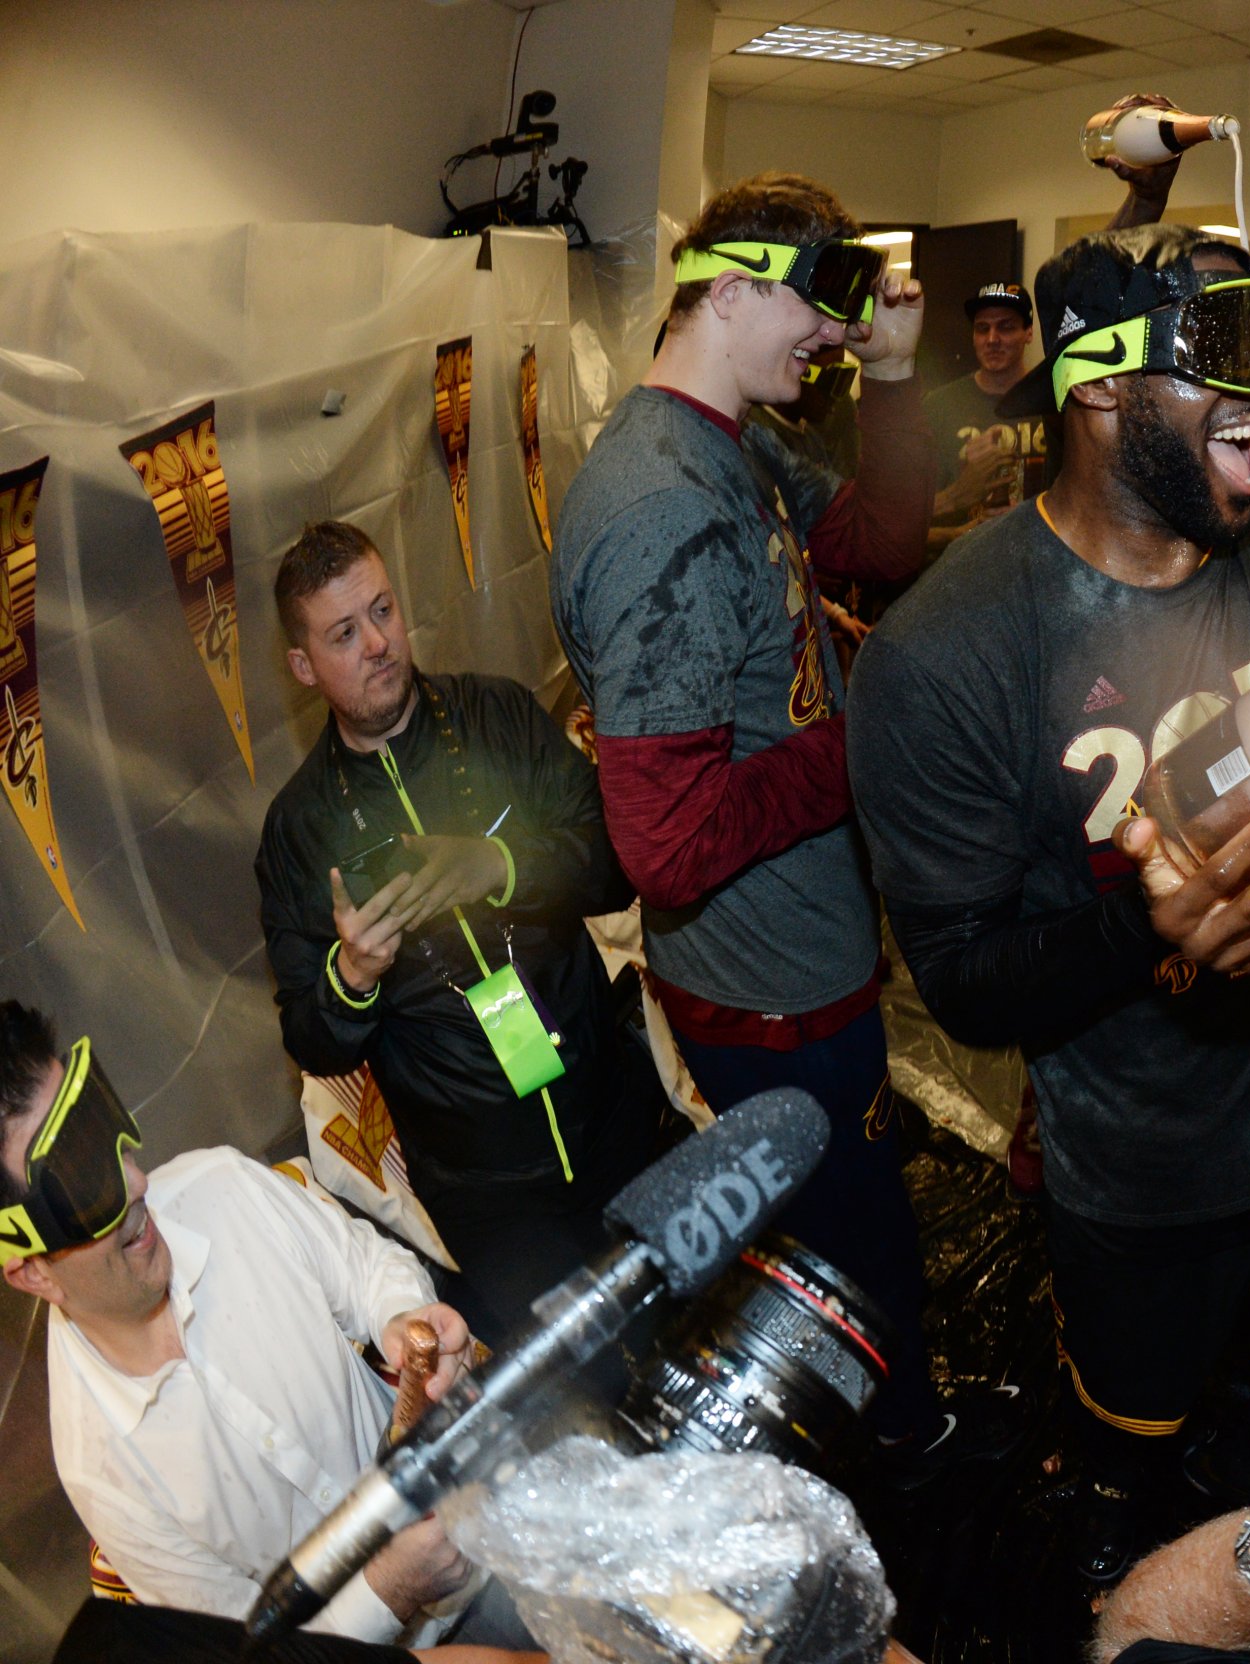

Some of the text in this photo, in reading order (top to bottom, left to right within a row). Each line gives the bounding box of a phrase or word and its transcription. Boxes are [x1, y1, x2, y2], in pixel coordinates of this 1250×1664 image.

[1058, 319, 1086, 338] adidas
[130, 418, 221, 496] 2016
[0, 478, 40, 553] 16
[353, 808, 366, 830] 2016
[667, 1138, 793, 1276] ØDE
